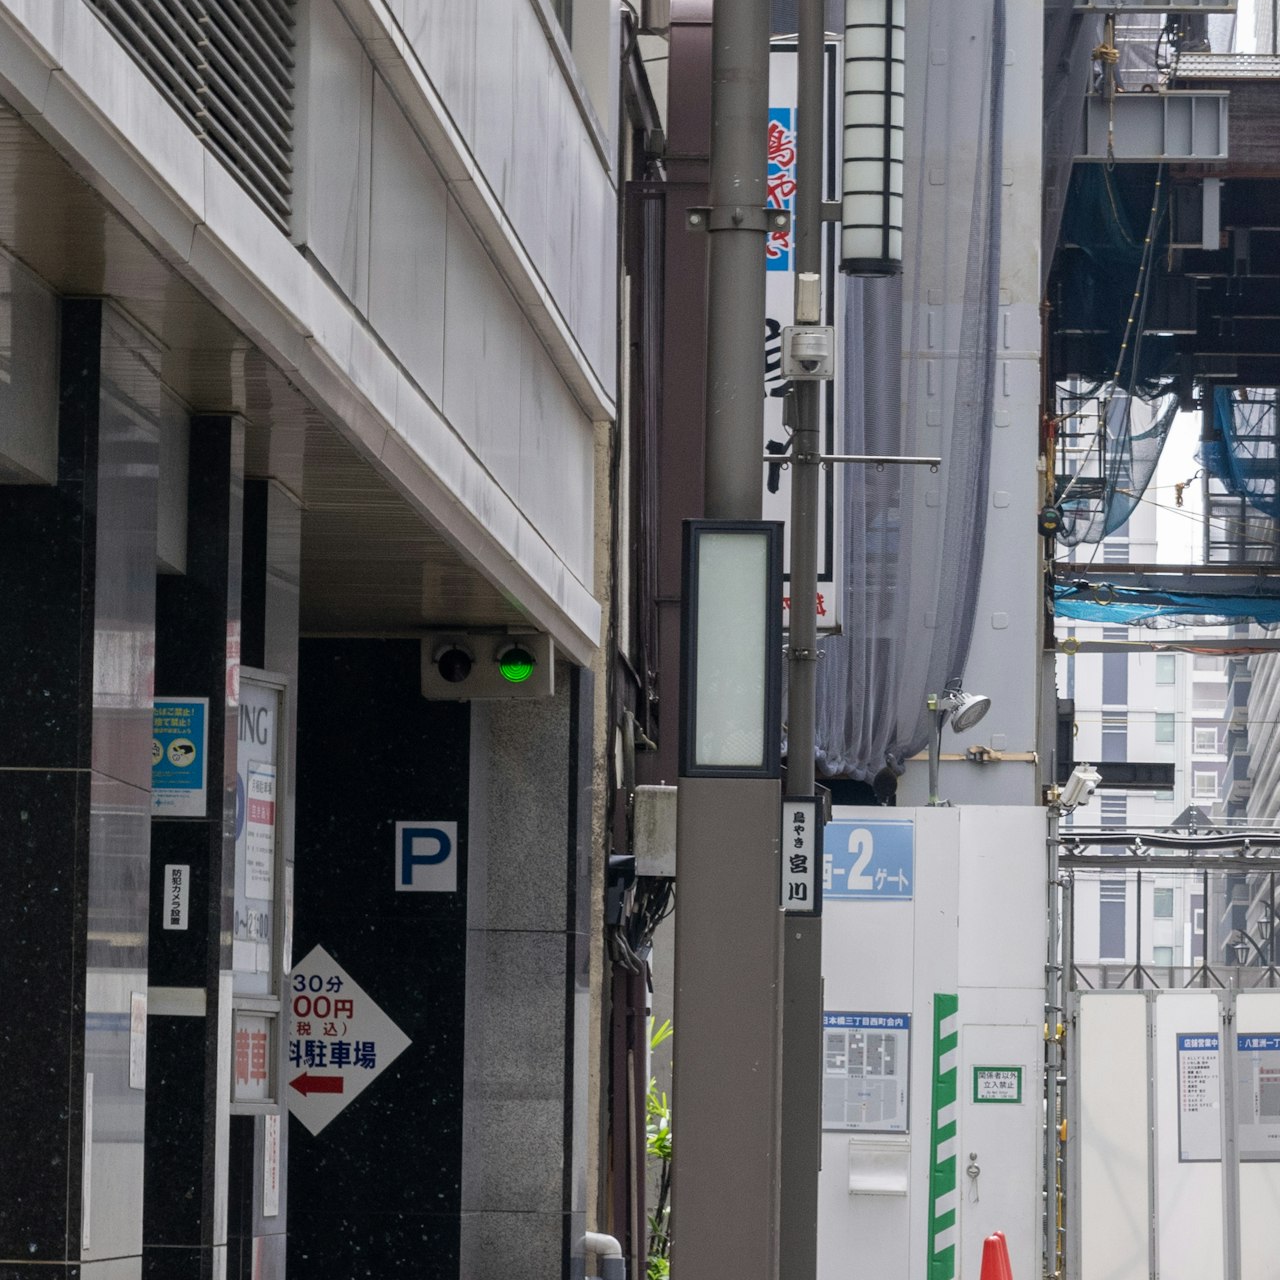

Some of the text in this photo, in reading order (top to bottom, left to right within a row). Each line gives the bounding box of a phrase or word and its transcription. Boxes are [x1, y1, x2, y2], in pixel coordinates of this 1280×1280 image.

[402, 828, 451, 886] P
[170, 869, 182, 925] 防犯カメラ設置
[292, 974, 344, 993] 30分
[289, 995, 354, 1019] 00円
